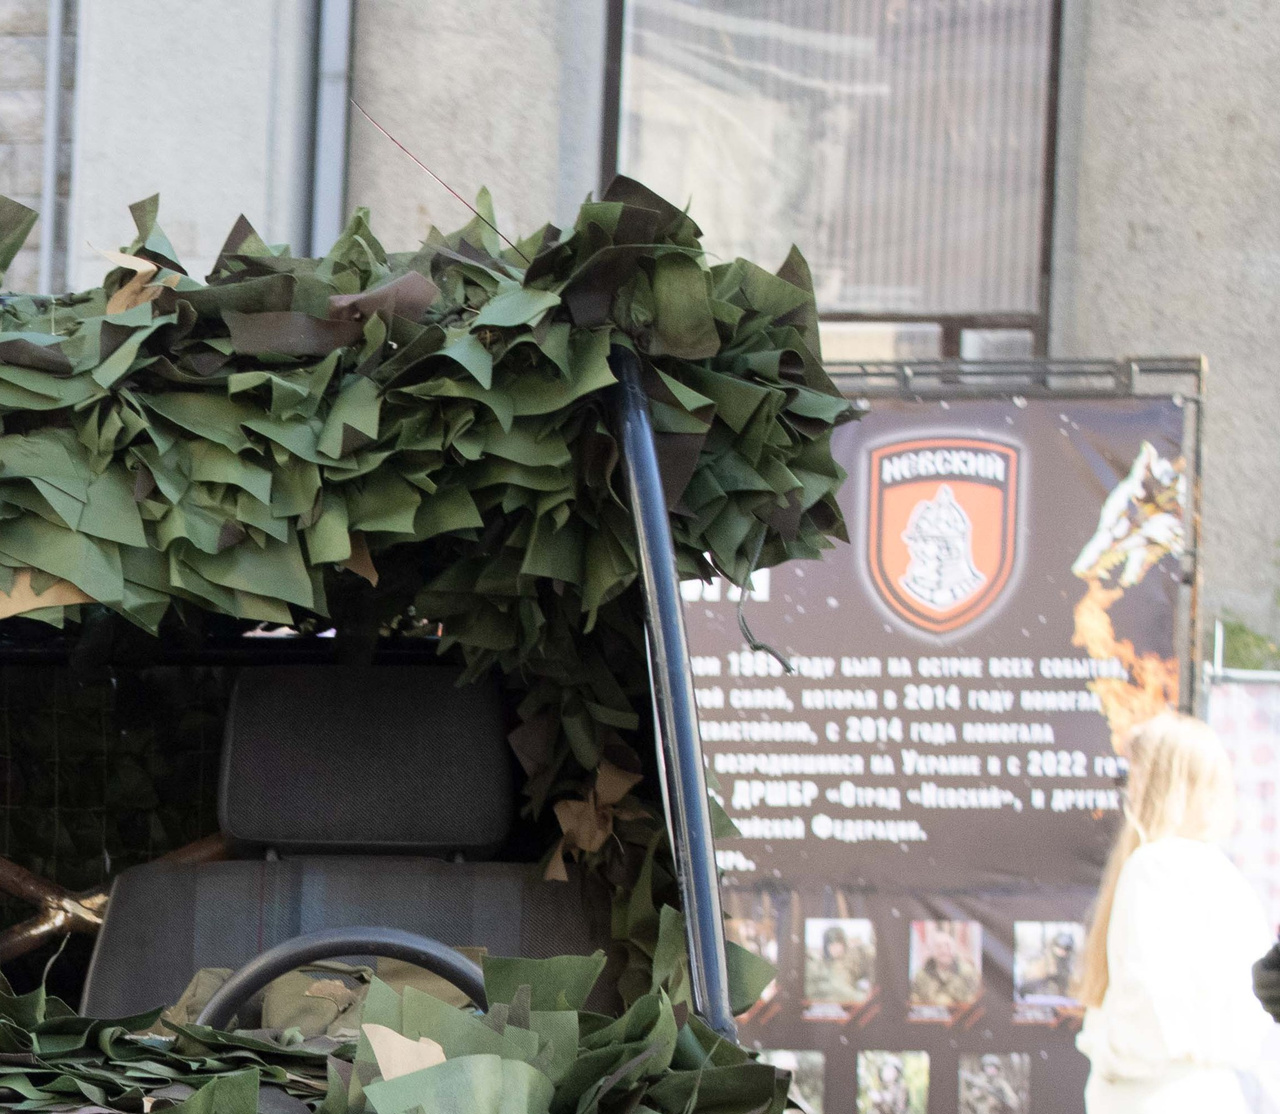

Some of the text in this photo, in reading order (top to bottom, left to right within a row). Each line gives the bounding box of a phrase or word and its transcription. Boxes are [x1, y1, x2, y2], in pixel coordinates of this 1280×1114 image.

[903, 683, 961, 711] 2014
[846, 716, 904, 743] 2014
[1026, 749, 1088, 777] 2022
